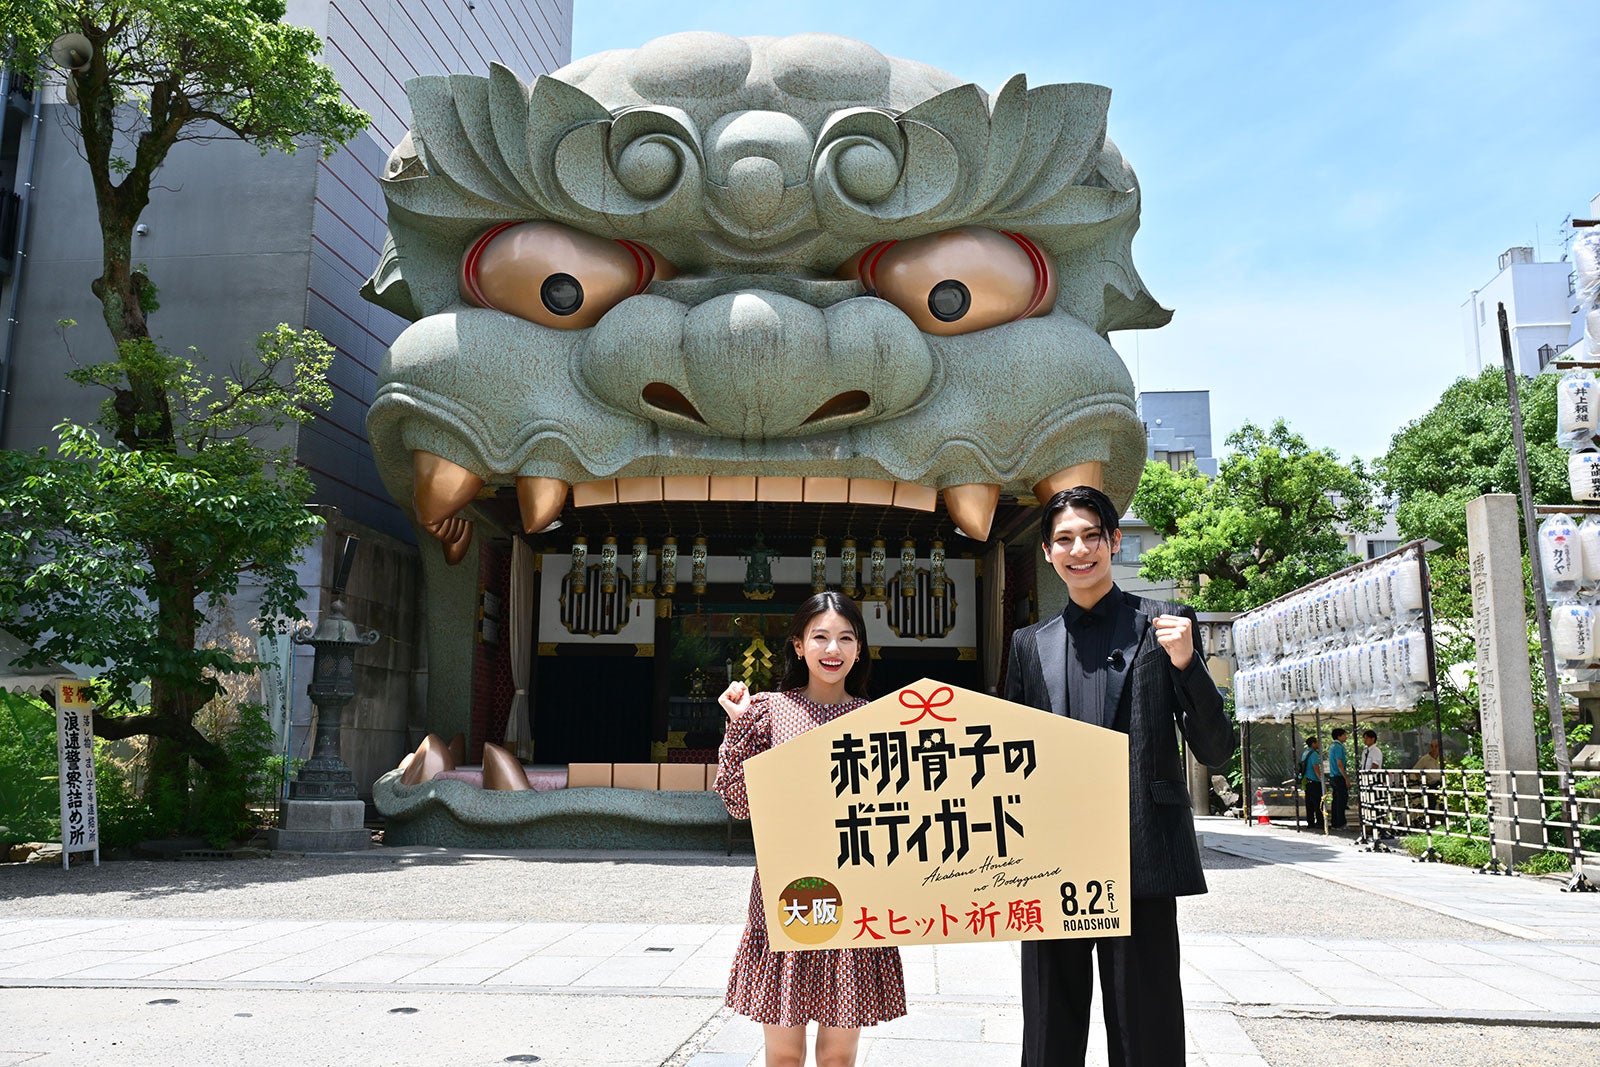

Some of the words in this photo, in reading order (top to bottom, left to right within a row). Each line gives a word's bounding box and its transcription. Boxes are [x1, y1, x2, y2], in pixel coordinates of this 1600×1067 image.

[64, 711, 86, 847] 浪速警察詰め所
[830, 725, 1037, 799] 赤羽骨子の
[834, 794, 1025, 869] ボディガード
[922, 865, 977, 887] Akabane
[979, 856, 1024, 872] Honeko
[973, 882, 990, 893] no
[992, 866, 1063, 889] Bodyguard
[782, 897, 839, 928] 大阪
[1060, 880, 1105, 917] 8.2
[852, 898, 1045, 941] 大ヒット祈願
[1062, 917, 1121, 932] ROADSHOW
